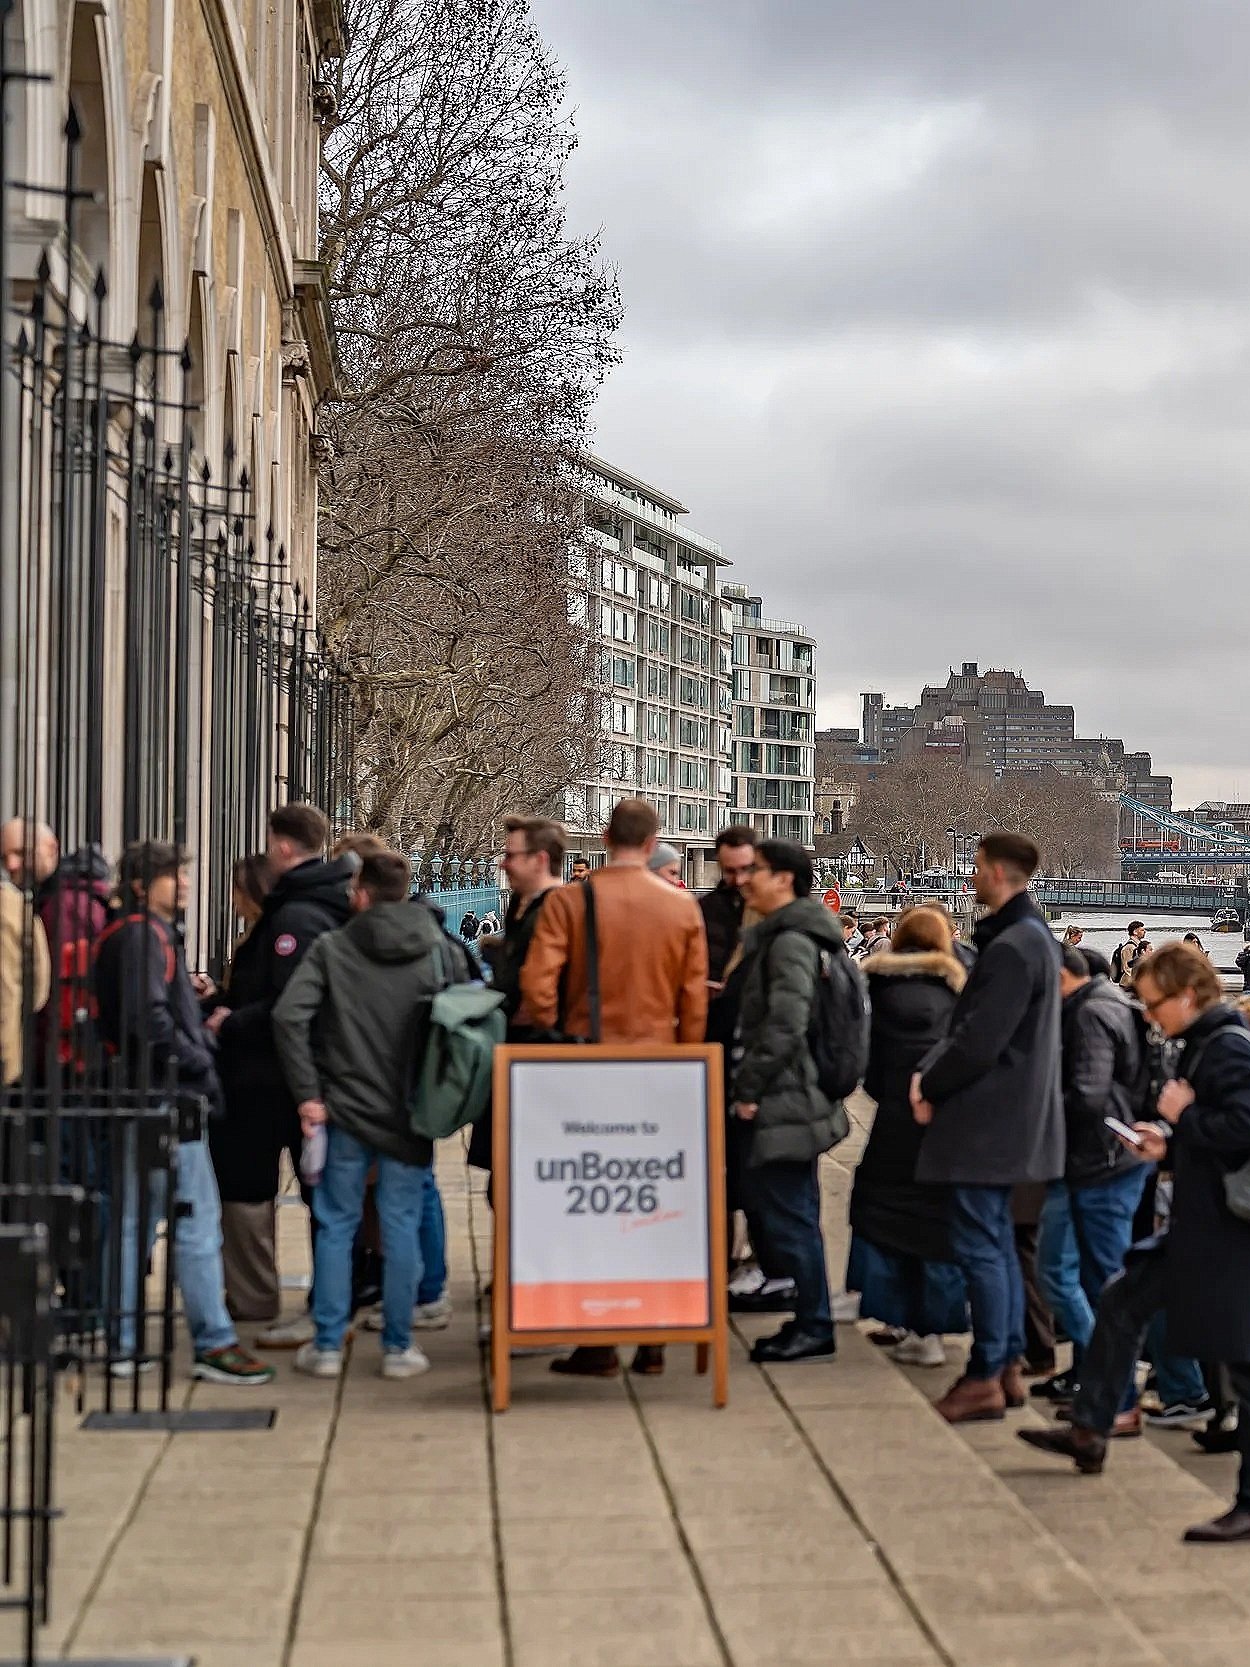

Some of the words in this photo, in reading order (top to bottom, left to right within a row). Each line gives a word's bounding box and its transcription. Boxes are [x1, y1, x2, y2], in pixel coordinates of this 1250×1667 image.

[564, 1121, 637, 1134] Welcome
[641, 1121, 659, 1134] to
[536, 1150, 685, 1181] unBoxed
[566, 1183, 658, 1214] 2026
